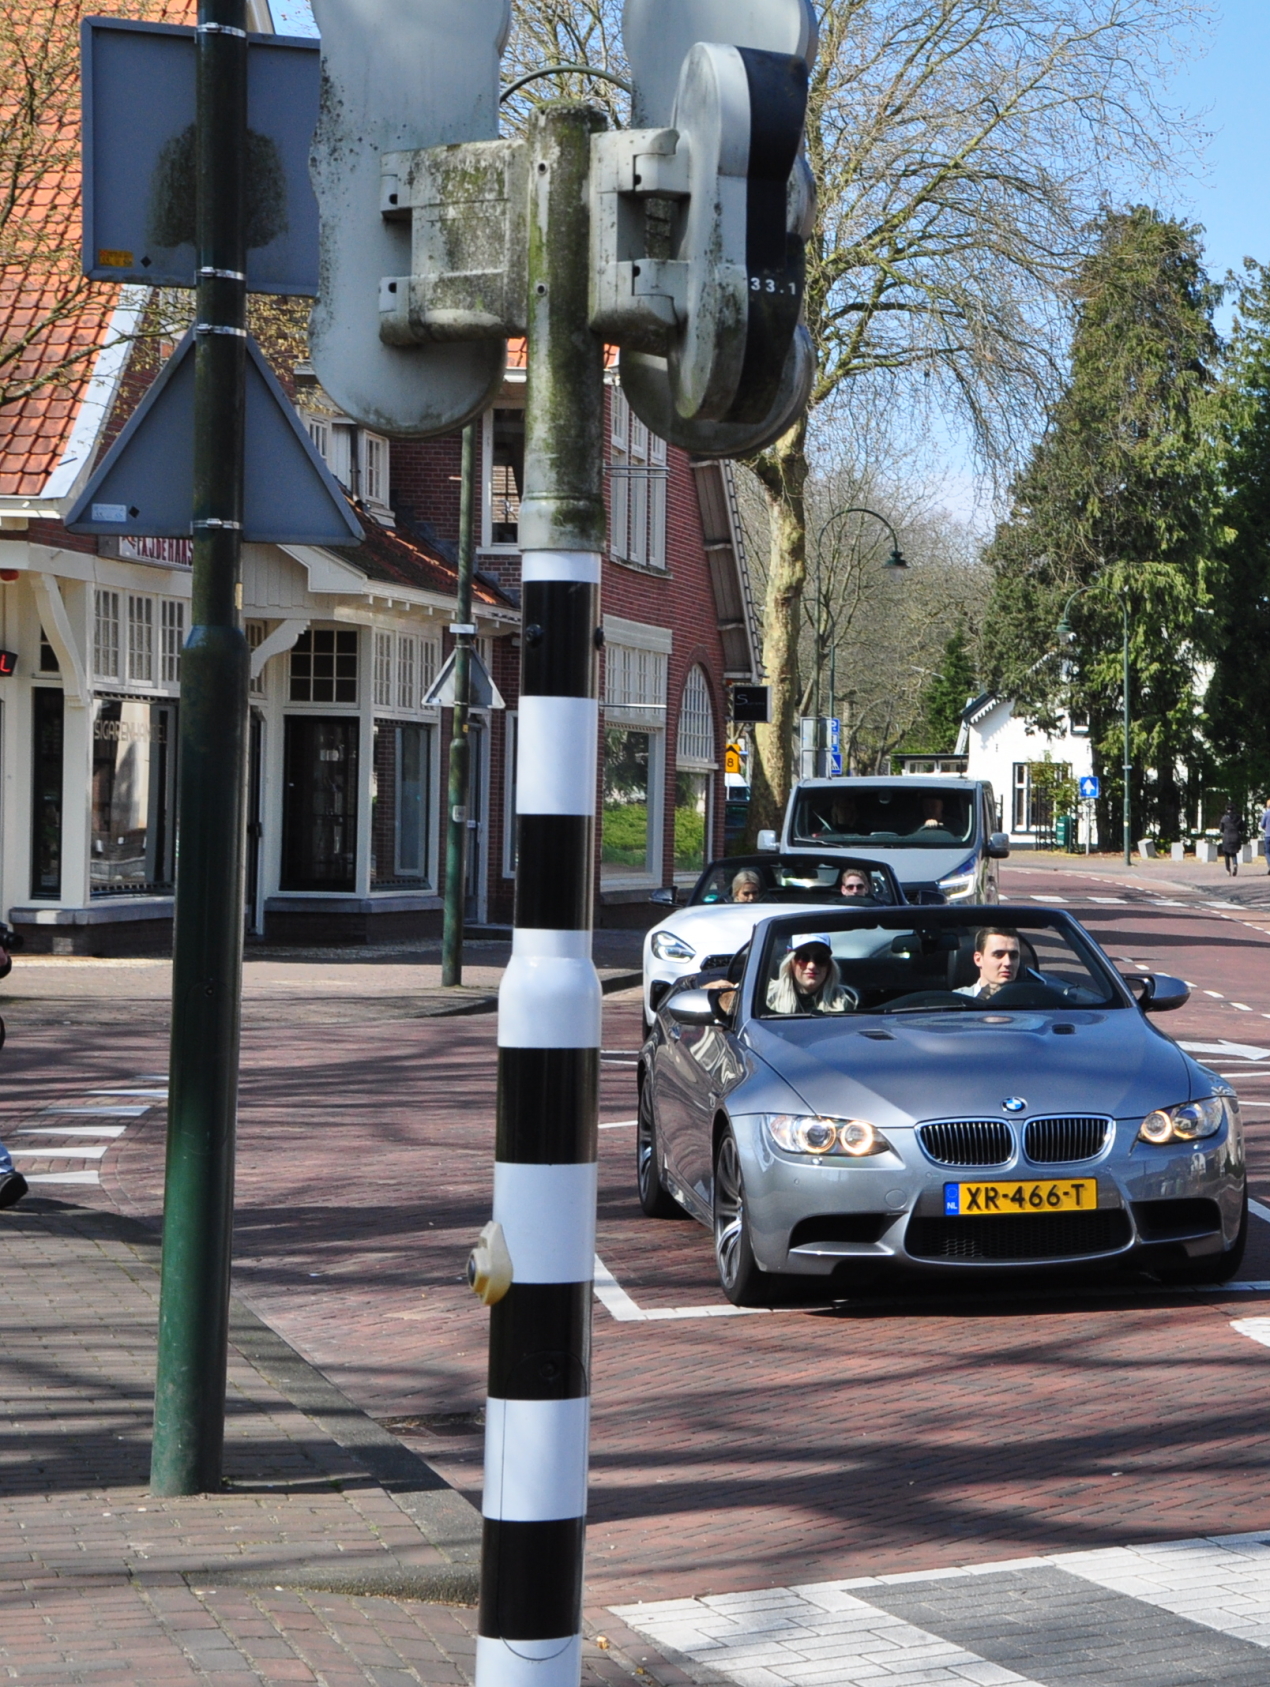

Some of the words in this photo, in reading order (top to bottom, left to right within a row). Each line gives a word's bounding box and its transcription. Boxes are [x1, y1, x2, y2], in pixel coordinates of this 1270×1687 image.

[750, 276, 796, 296] 33.1
[946, 1202, 958, 1210] NL
[966, 1183, 1085, 1211] XR-466-T
